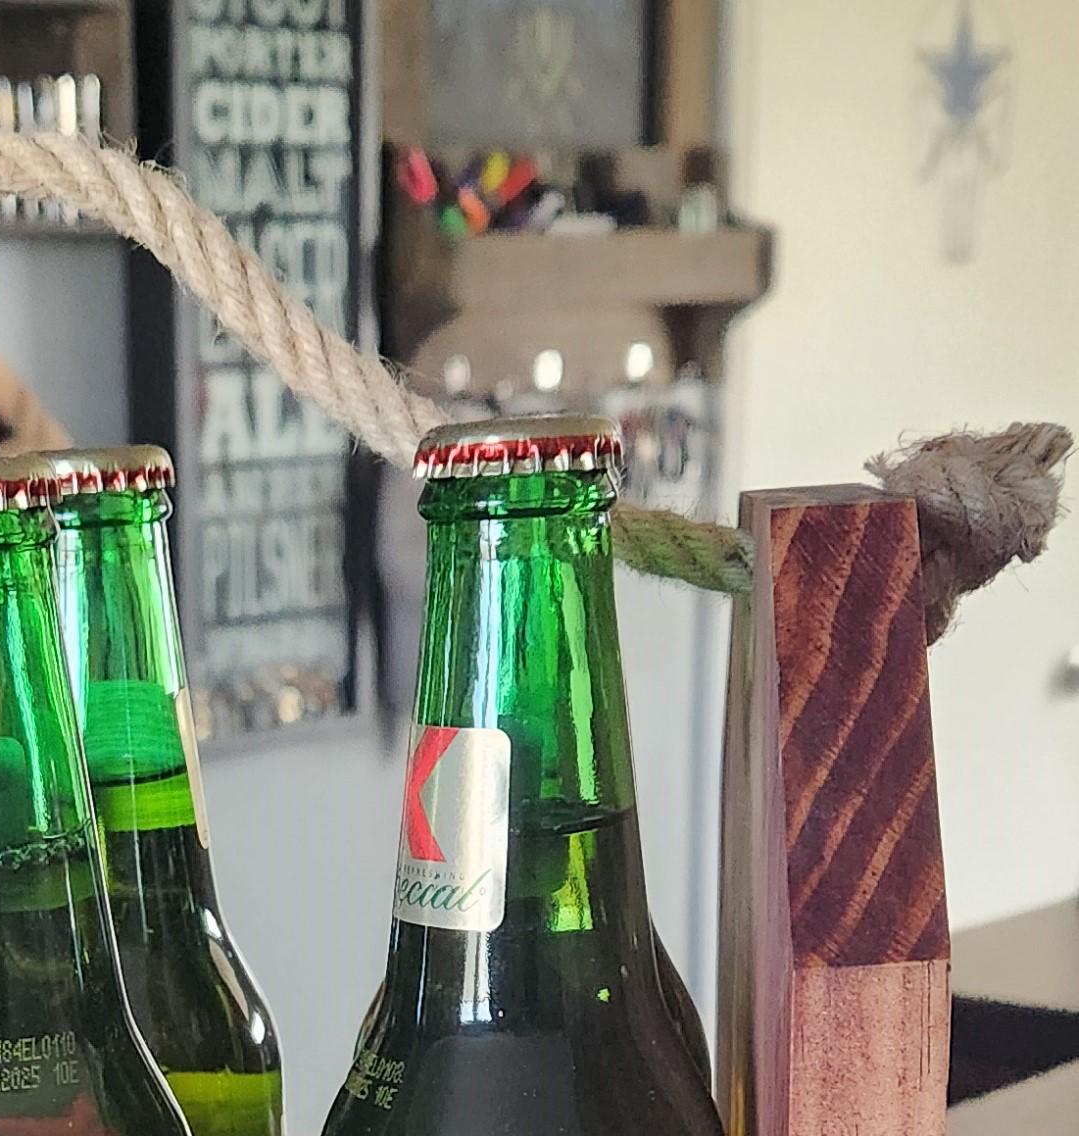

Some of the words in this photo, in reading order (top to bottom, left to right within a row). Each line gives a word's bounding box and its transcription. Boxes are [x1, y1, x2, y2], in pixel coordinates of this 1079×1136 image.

[195, 81, 352, 146] CIDER
[199, 149, 352, 214] MALT
[201, 368, 347, 462] ALE
[52, 1060, 81, 1086] 10E
